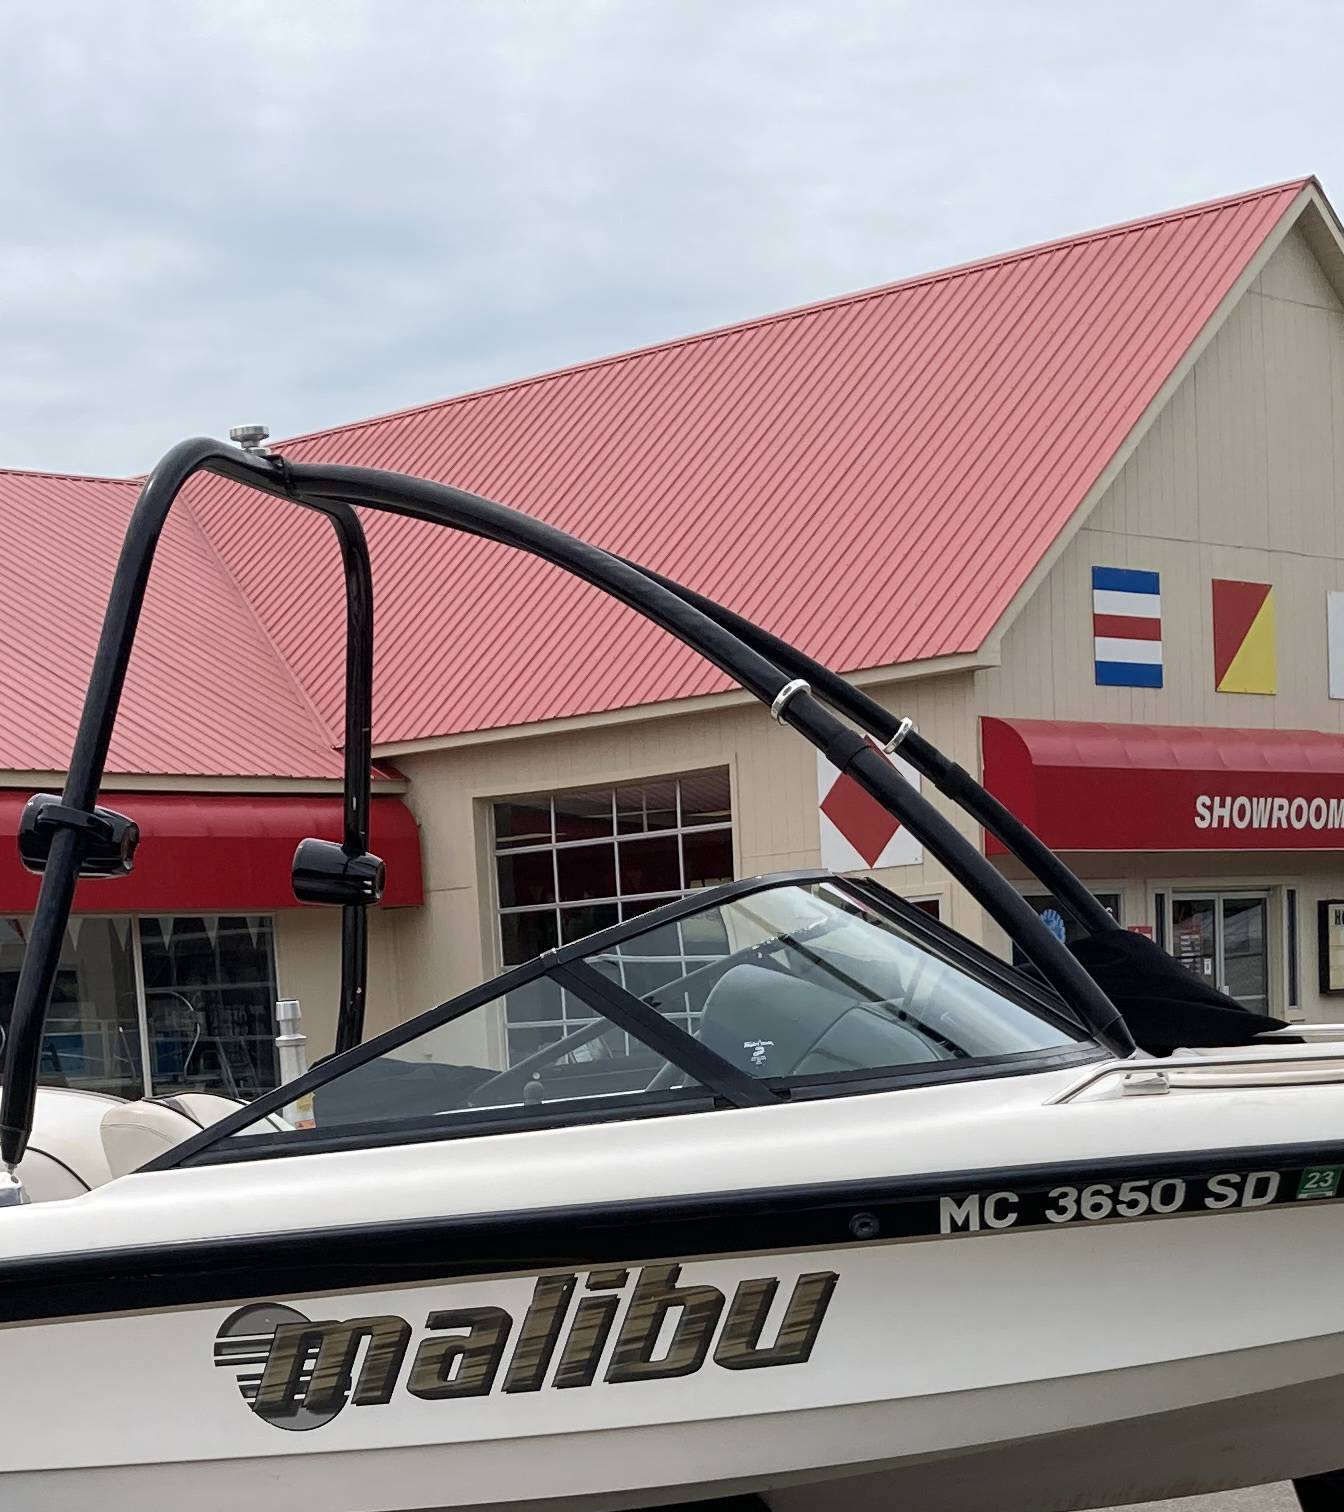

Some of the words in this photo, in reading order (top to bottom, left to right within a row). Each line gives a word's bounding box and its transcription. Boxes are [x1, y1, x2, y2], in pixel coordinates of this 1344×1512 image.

[939, 1191, 1020, 1235] MC
[1045, 1179, 1187, 1223] 3650
[1204, 1170, 1281, 1209] SD
[1304, 1170, 1335, 1189] 23
[252, 1262, 840, 1412] malibu
